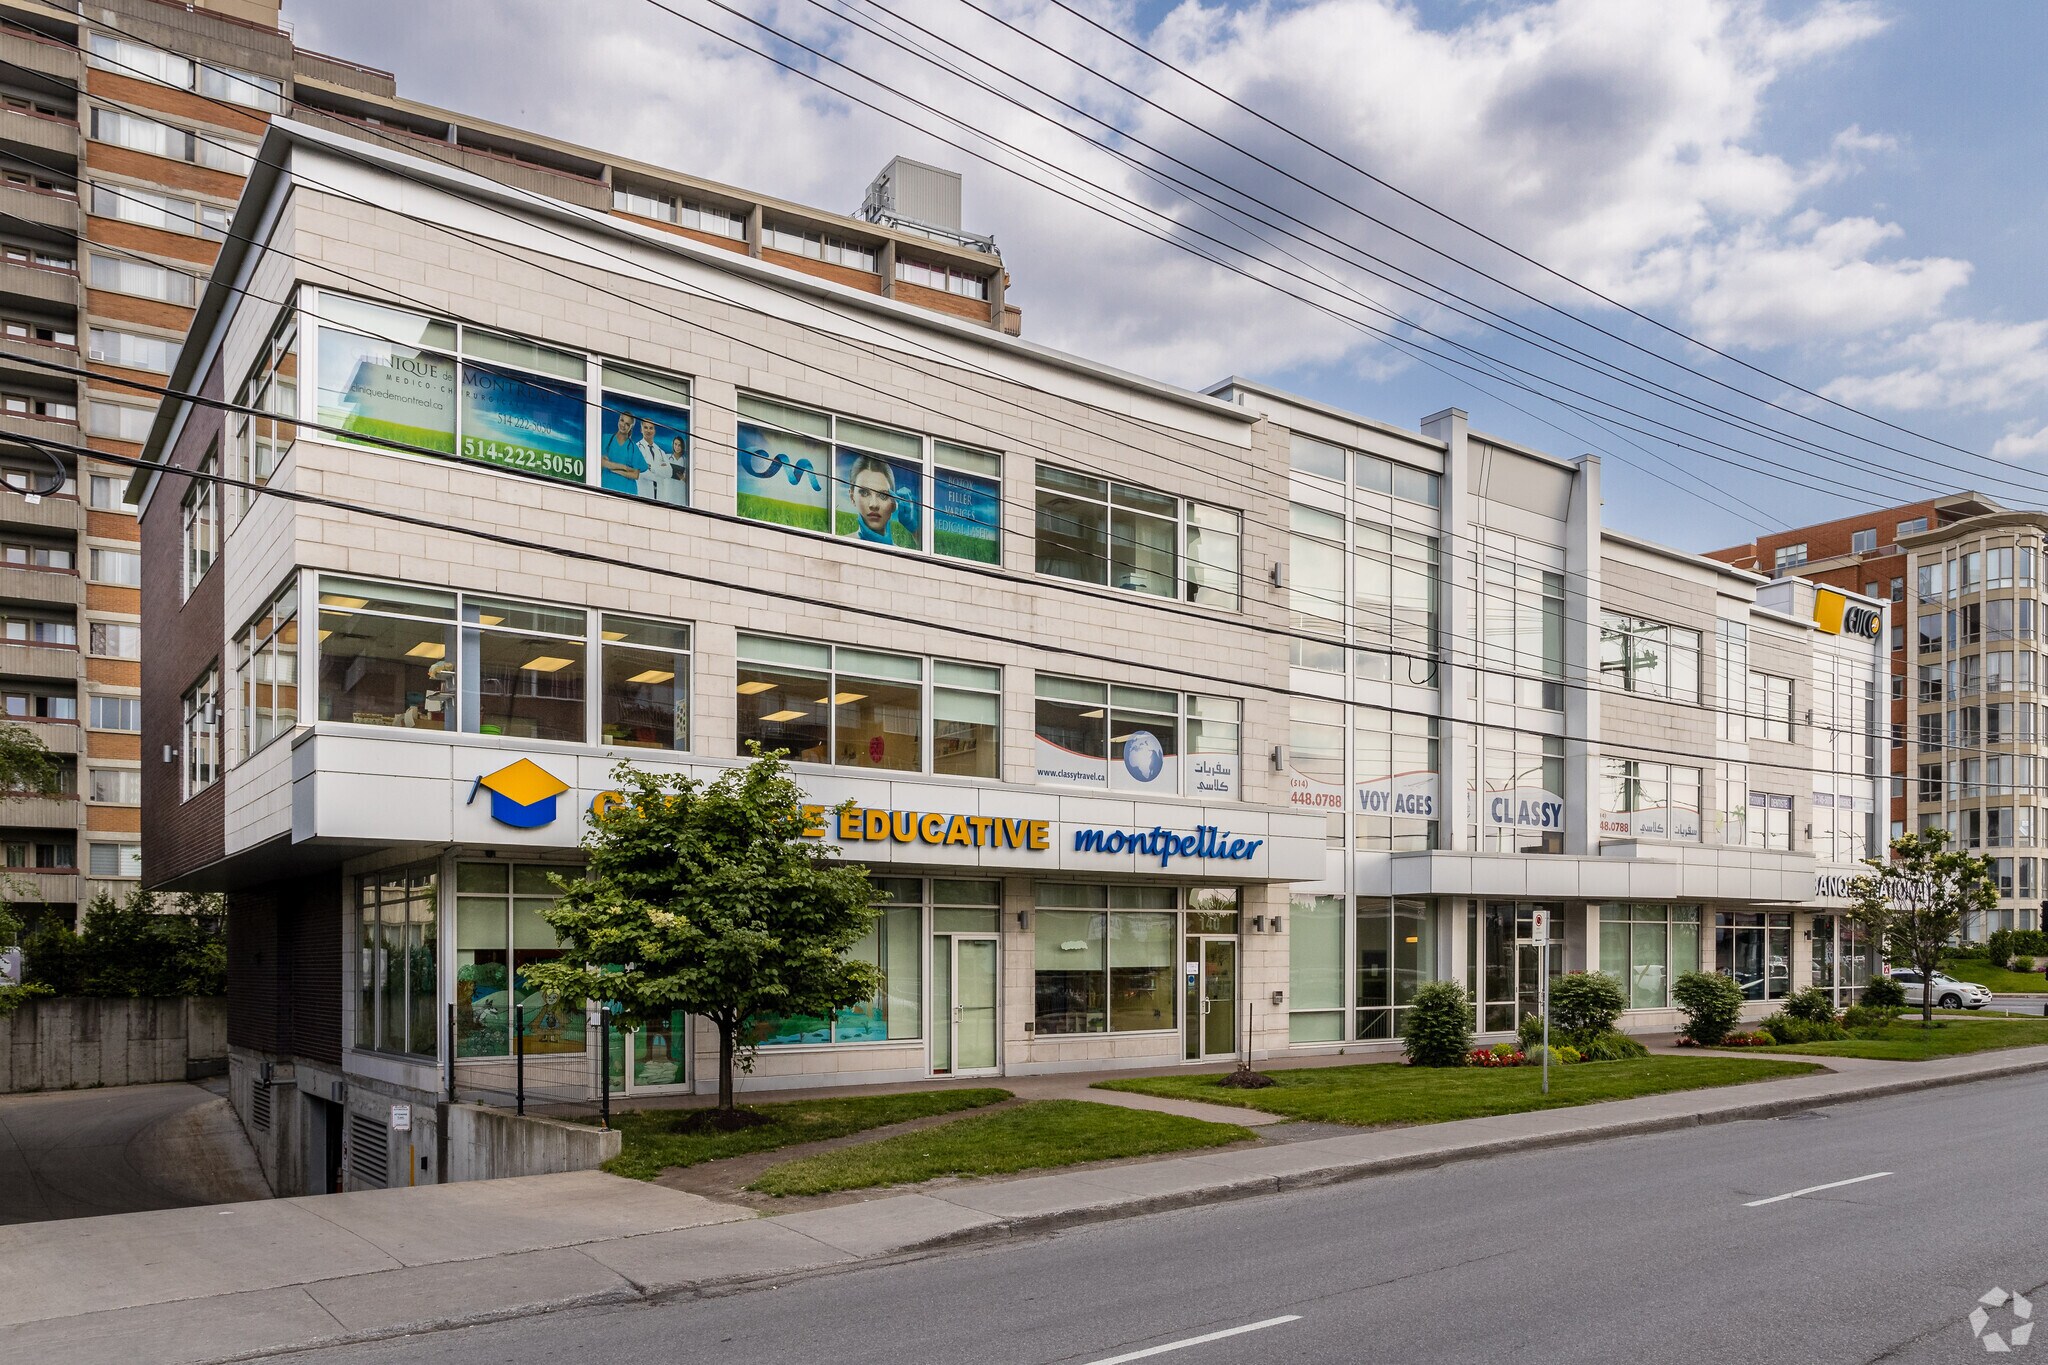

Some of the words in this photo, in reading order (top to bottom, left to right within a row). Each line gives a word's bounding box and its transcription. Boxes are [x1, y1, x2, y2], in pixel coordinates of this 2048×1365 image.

[464, 438, 584, 477] 514-222-5050
[948, 491, 972, 505] FILLER
[1037, 768, 1106, 782] www.classytravel.ca
[1194, 761, 1231, 777] سفريات
[1196, 779, 1229, 793] كلاسي
[1290, 778, 1309, 789] (514)
[1291, 791, 1342, 808] 448.0788
[1359, 789, 1432, 816] VOYAGES
[1491, 797, 1562, 828] CLASSY
[837, 801, 1050, 850] ÉDUCATIVE
[1074, 825, 1264, 867] montpellier
[1600, 820, 1629, 833] 48.0788
[1200, 916, 1220, 931] 140
